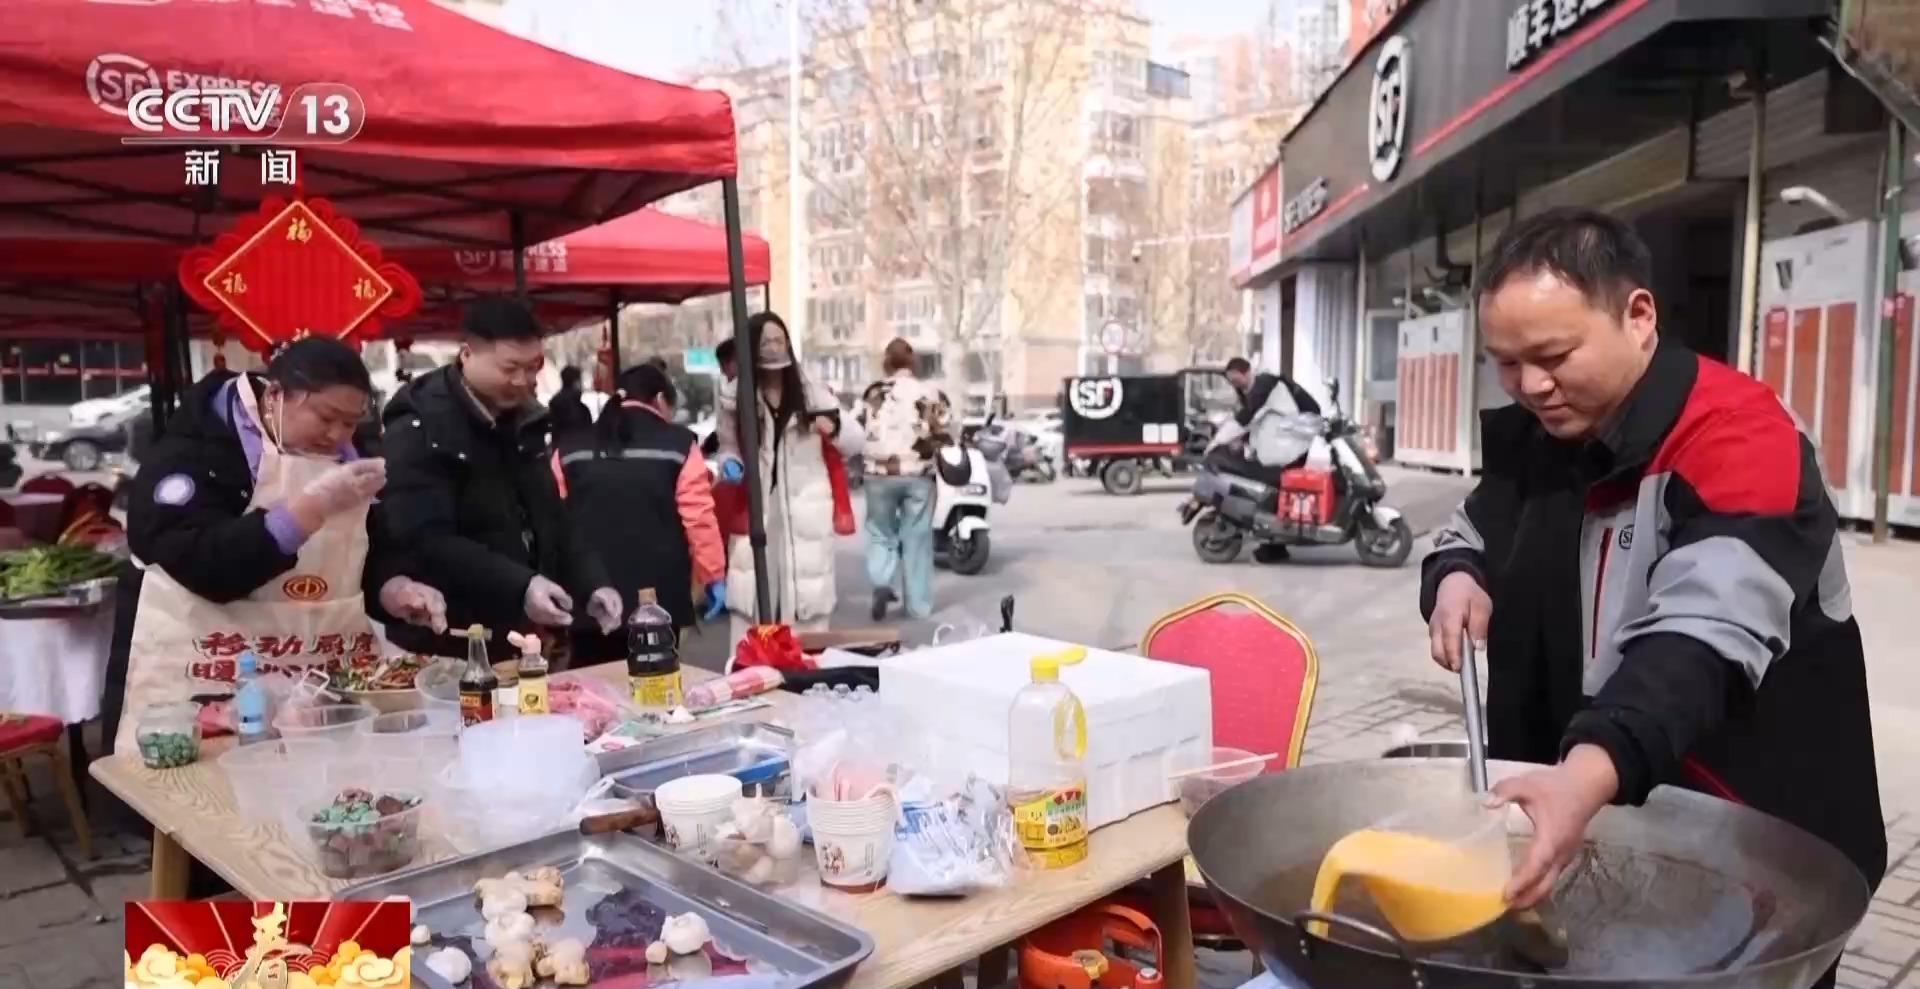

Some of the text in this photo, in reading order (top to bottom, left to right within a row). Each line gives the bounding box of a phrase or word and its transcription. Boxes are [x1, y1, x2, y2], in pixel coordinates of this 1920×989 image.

[286, 217, 313, 244] 福
[222, 271, 248, 295] 福
[352, 277, 377, 300] 福
